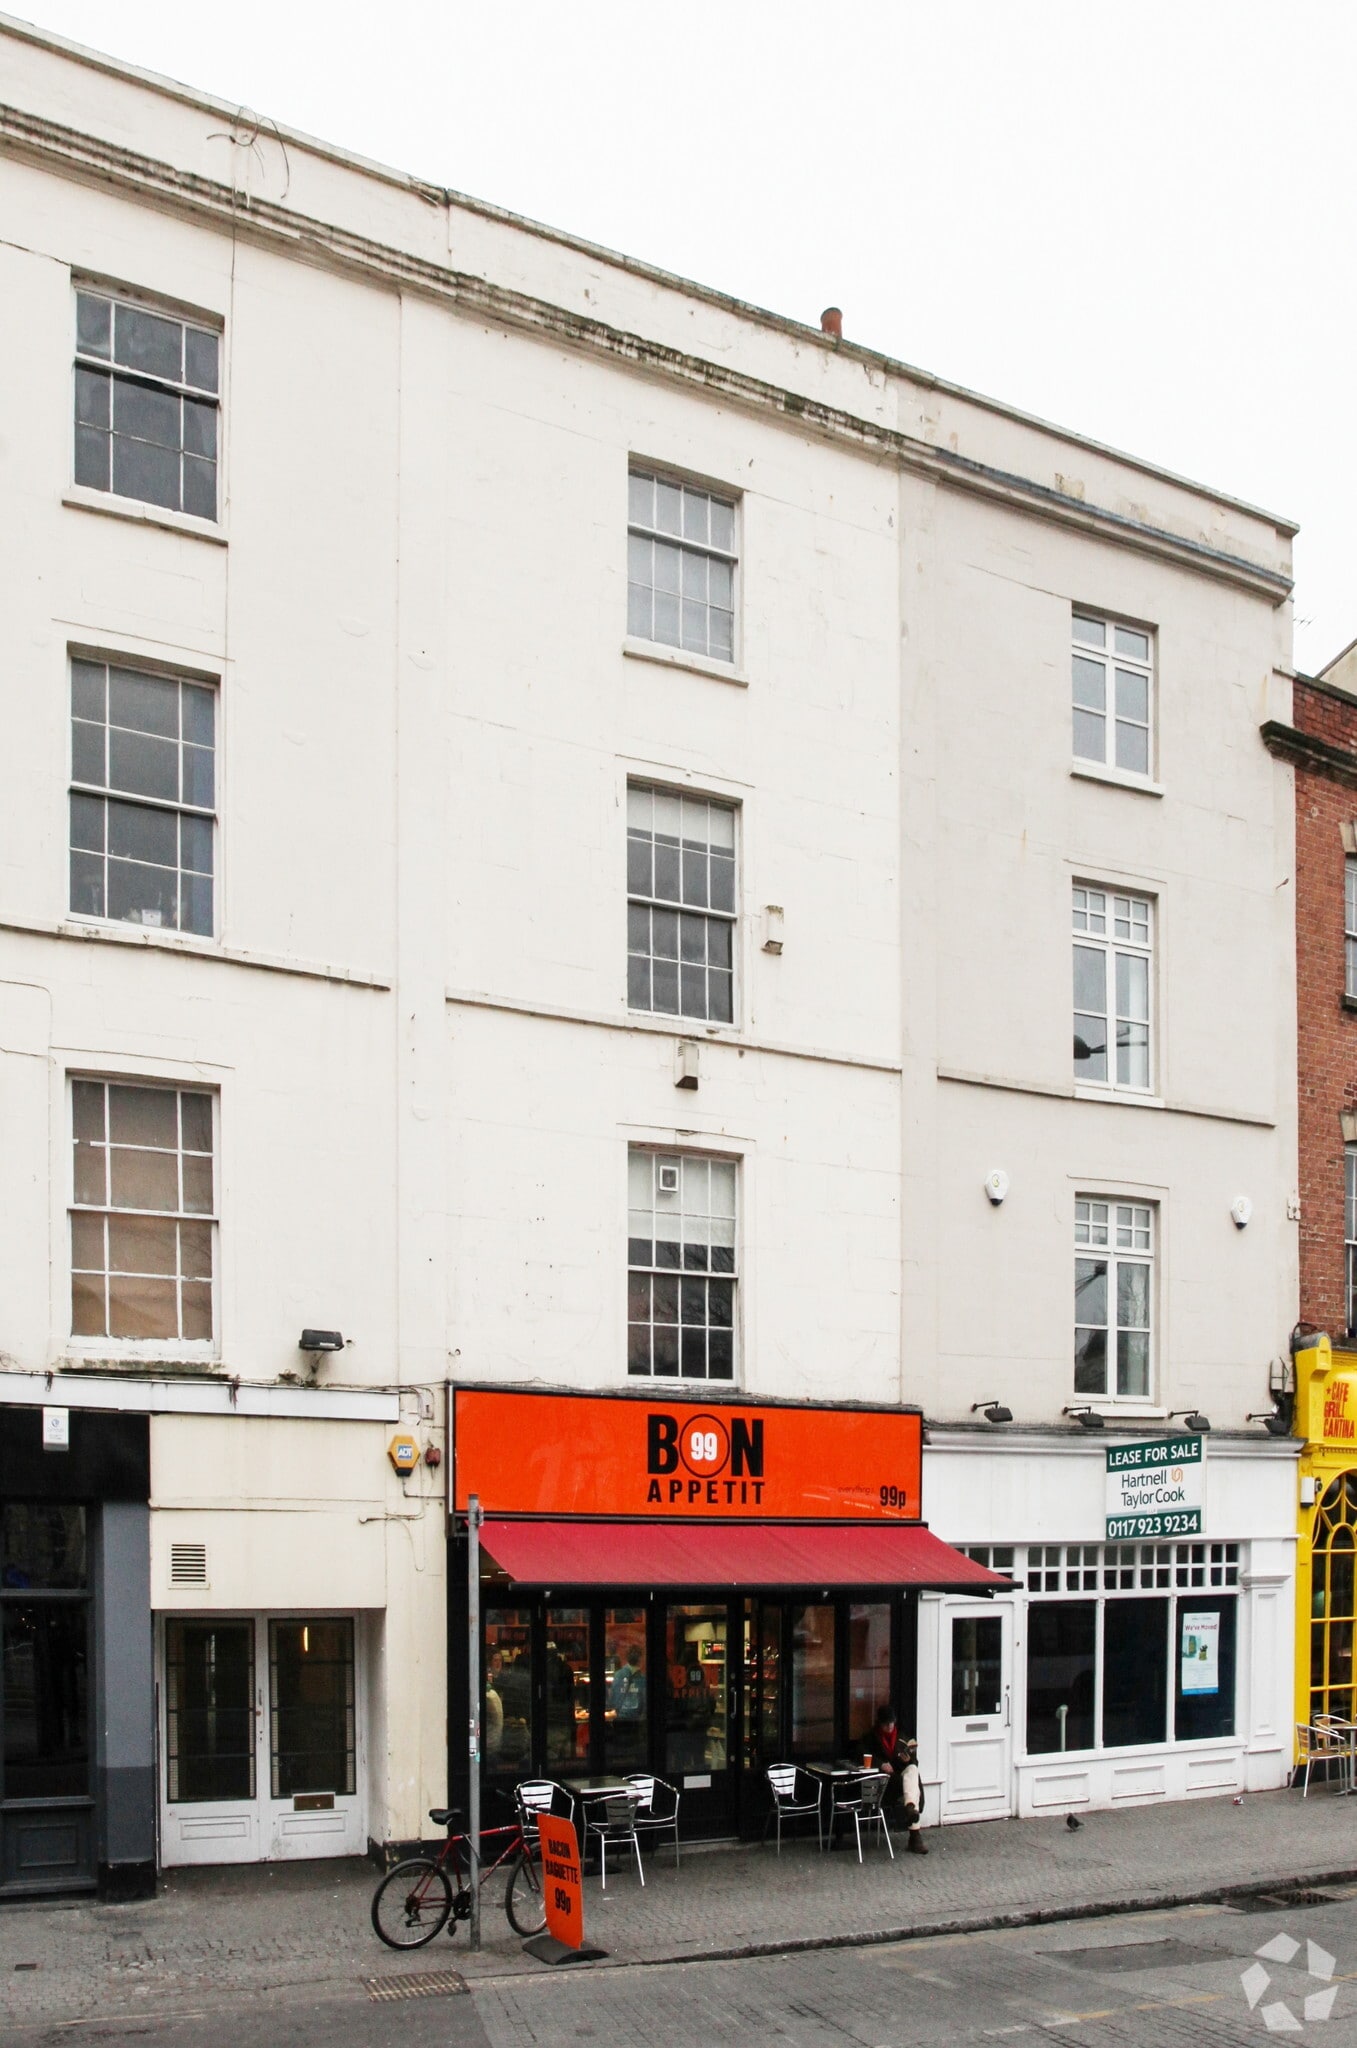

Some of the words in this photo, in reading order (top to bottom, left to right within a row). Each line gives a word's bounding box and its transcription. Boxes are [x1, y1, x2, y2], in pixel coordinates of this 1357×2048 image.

[1323, 1418, 1355, 1438] CANTINA
[398, 1448, 412, 1457] ADT
[690, 1431, 718, 1461] 99
[1109, 1450, 1142, 1466] LEASE
[1145, 1446, 1168, 1462] FOR
[1170, 1442, 1199, 1459] SALE
[1121, 1469, 1167, 1488] Hartnell
[647, 1479, 765, 1504] APPETIT
[880, 1485, 906, 1509] 99p
[1108, 1519, 1136, 1537] 0117
[1138, 1517, 1161, 1535] 923
[1164, 1514, 1198, 1533] 9234
[548, 1839, 571, 1858] BACON
[545, 1860, 579, 1884] BAGUETTE
[554, 1887, 571, 1915] 99p
